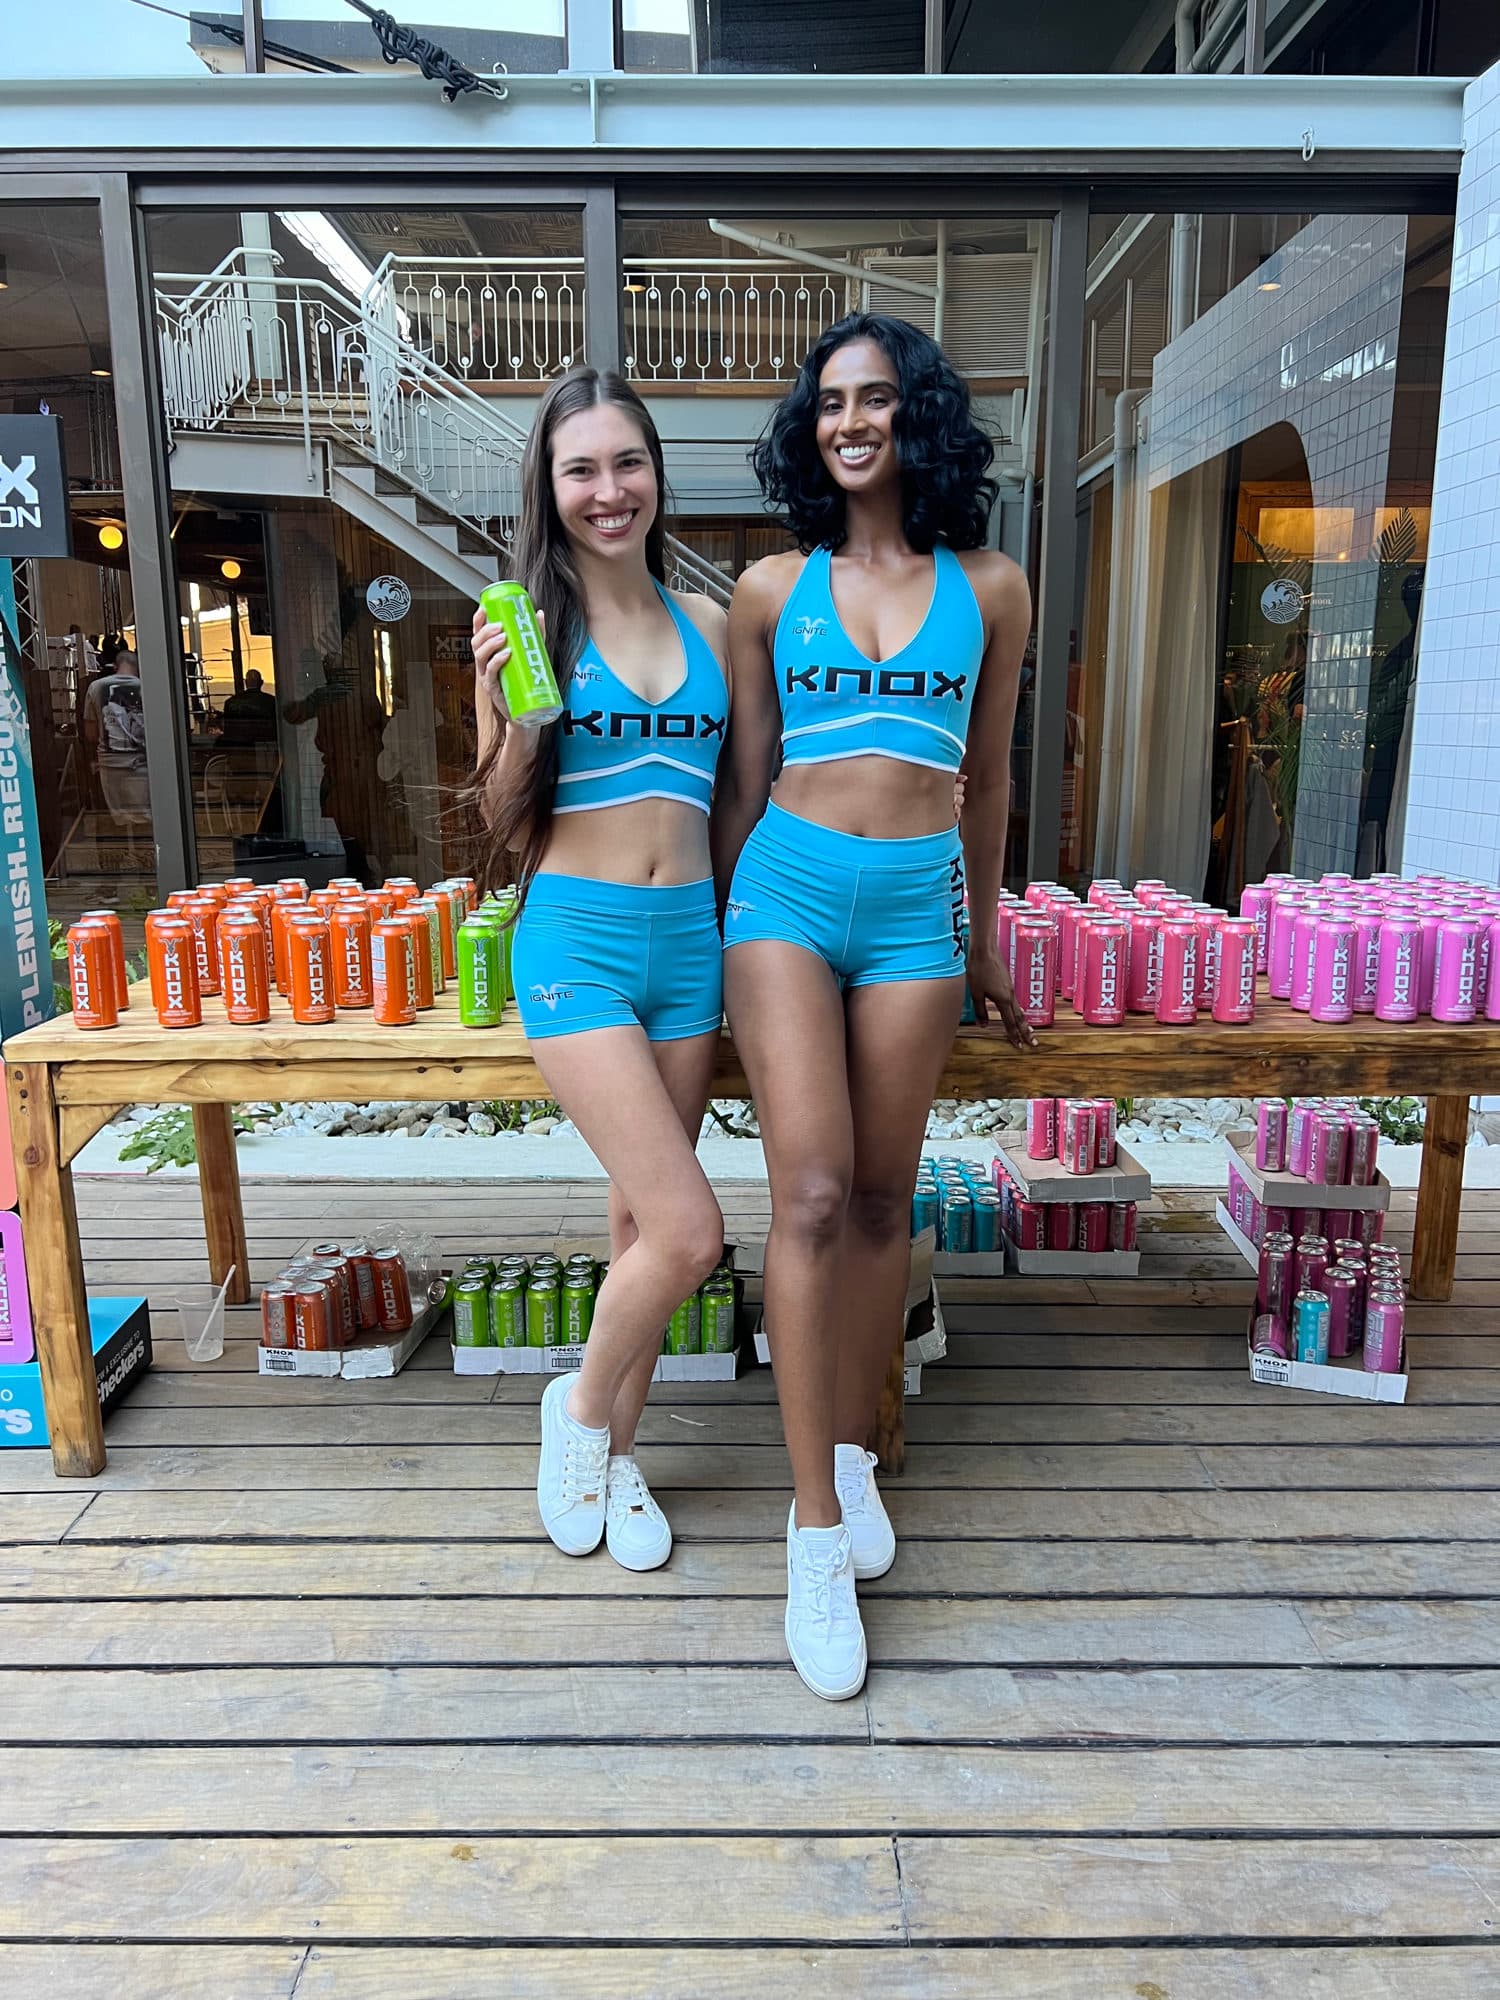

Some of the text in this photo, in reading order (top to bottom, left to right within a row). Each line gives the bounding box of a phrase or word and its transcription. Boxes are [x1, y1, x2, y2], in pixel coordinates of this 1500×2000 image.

[515, 613, 549, 685] KNOX
[792, 626, 828, 636] IGNITE
[570, 671, 603, 682] NITE
[787, 665, 967, 703] KNOX
[563, 710, 726, 741] KNOX
[193, 928, 209, 979] KNOX
[229, 950, 247, 1006] KNOX
[308, 950, 325, 1006] KNOX
[345, 937, 361, 990] KNOX
[473, 953, 488, 1008] KNOX
[1029, 952, 1045, 1008] KNOX
[1101, 950, 1116, 1007] KNOX
[1182, 949, 1196, 1005] KNOX
[1240, 949, 1254, 1005] KNOX
[1331, 948, 1348, 1004] KNOX
[1394, 947, 1411, 1003] KNOX
[1458, 948, 1476, 1004] KNOX
[73, 953, 90, 1010] KNOX
[164, 953, 183, 1009] KNOX
[529, 990, 575, 1003] IGNITE
[1036, 1221, 1045, 1250] KNO
[1079, 1220, 1088, 1250] KNO
[381, 1279, 398, 1320] KNOX
[569, 1310, 580, 1343] KNO
[295, 1313, 307, 1349] KNO
[544, 1311, 554, 1345] KNO
[97, 1340, 145, 1403] heckers
[1255, 1358, 1288, 1368] KNOX
